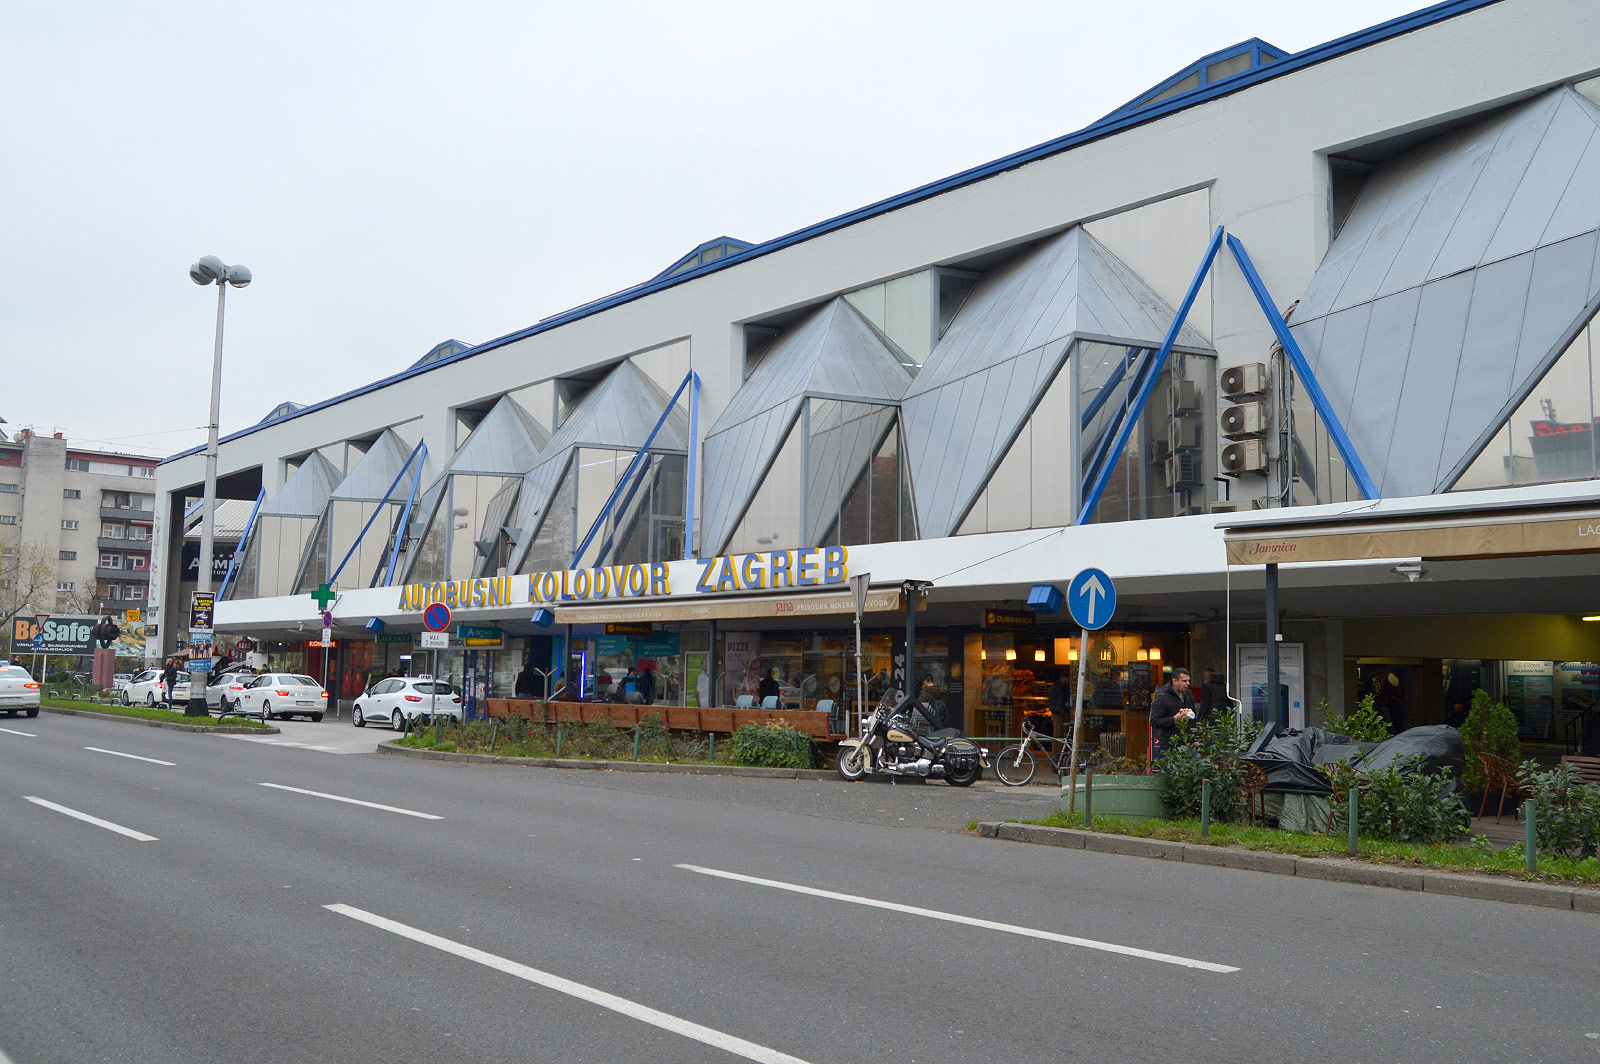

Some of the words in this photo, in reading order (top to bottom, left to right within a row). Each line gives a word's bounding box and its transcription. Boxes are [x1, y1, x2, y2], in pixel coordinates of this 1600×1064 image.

[1249, 542, 1297, 555] Jamnica
[398, 576, 512, 610] AUTOBUSNI
[528, 561, 672, 602] KOLODVOR
[696, 545, 849, 593] ZAGREB
[996, 615, 1033, 624] DUBRAVICA
[727, 642, 750, 652] PIZZE
